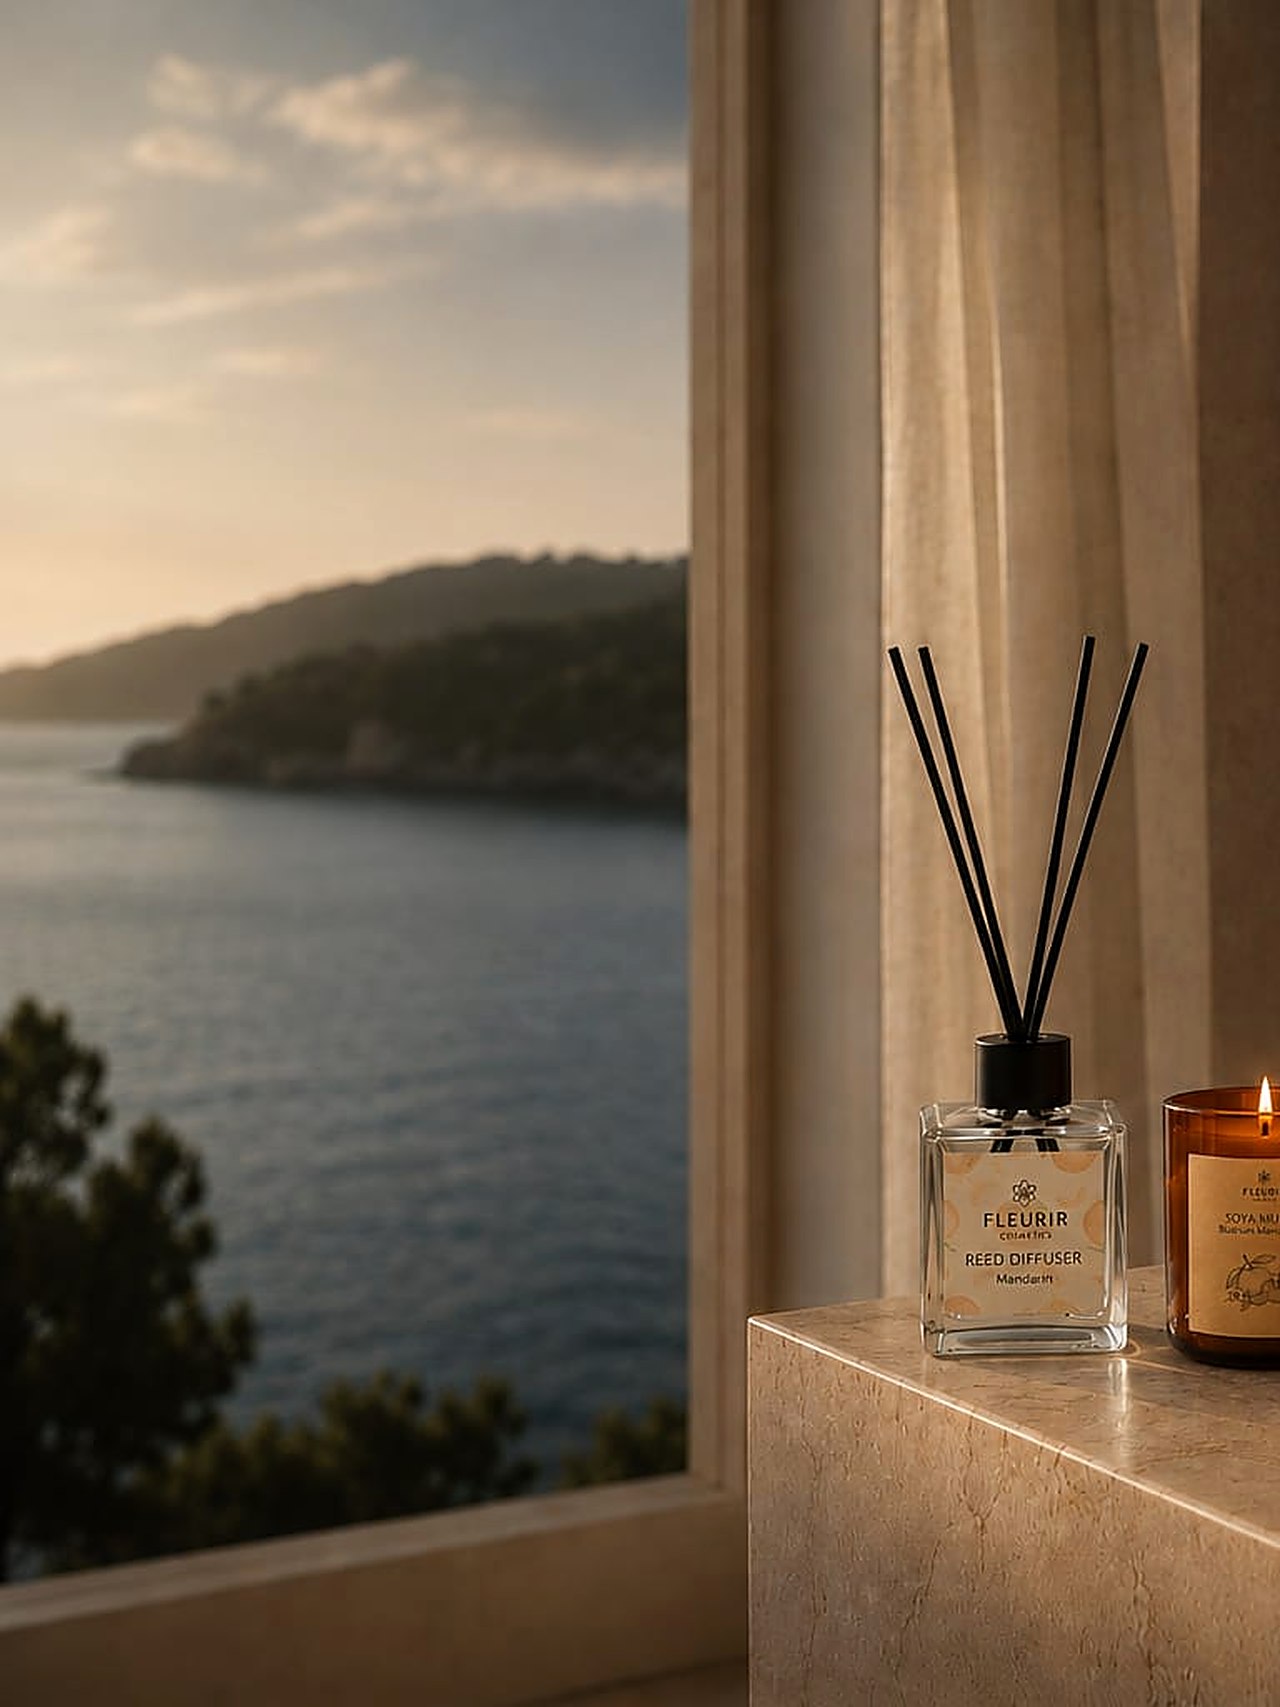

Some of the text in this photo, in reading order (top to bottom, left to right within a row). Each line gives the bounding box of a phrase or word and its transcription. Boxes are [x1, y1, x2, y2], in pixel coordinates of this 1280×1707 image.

[983, 1211, 1068, 1228] FLEURIR
[1225, 1213, 1256, 1224] SOYA
[965, 1251, 1082, 1267] REED DIFFUSER
